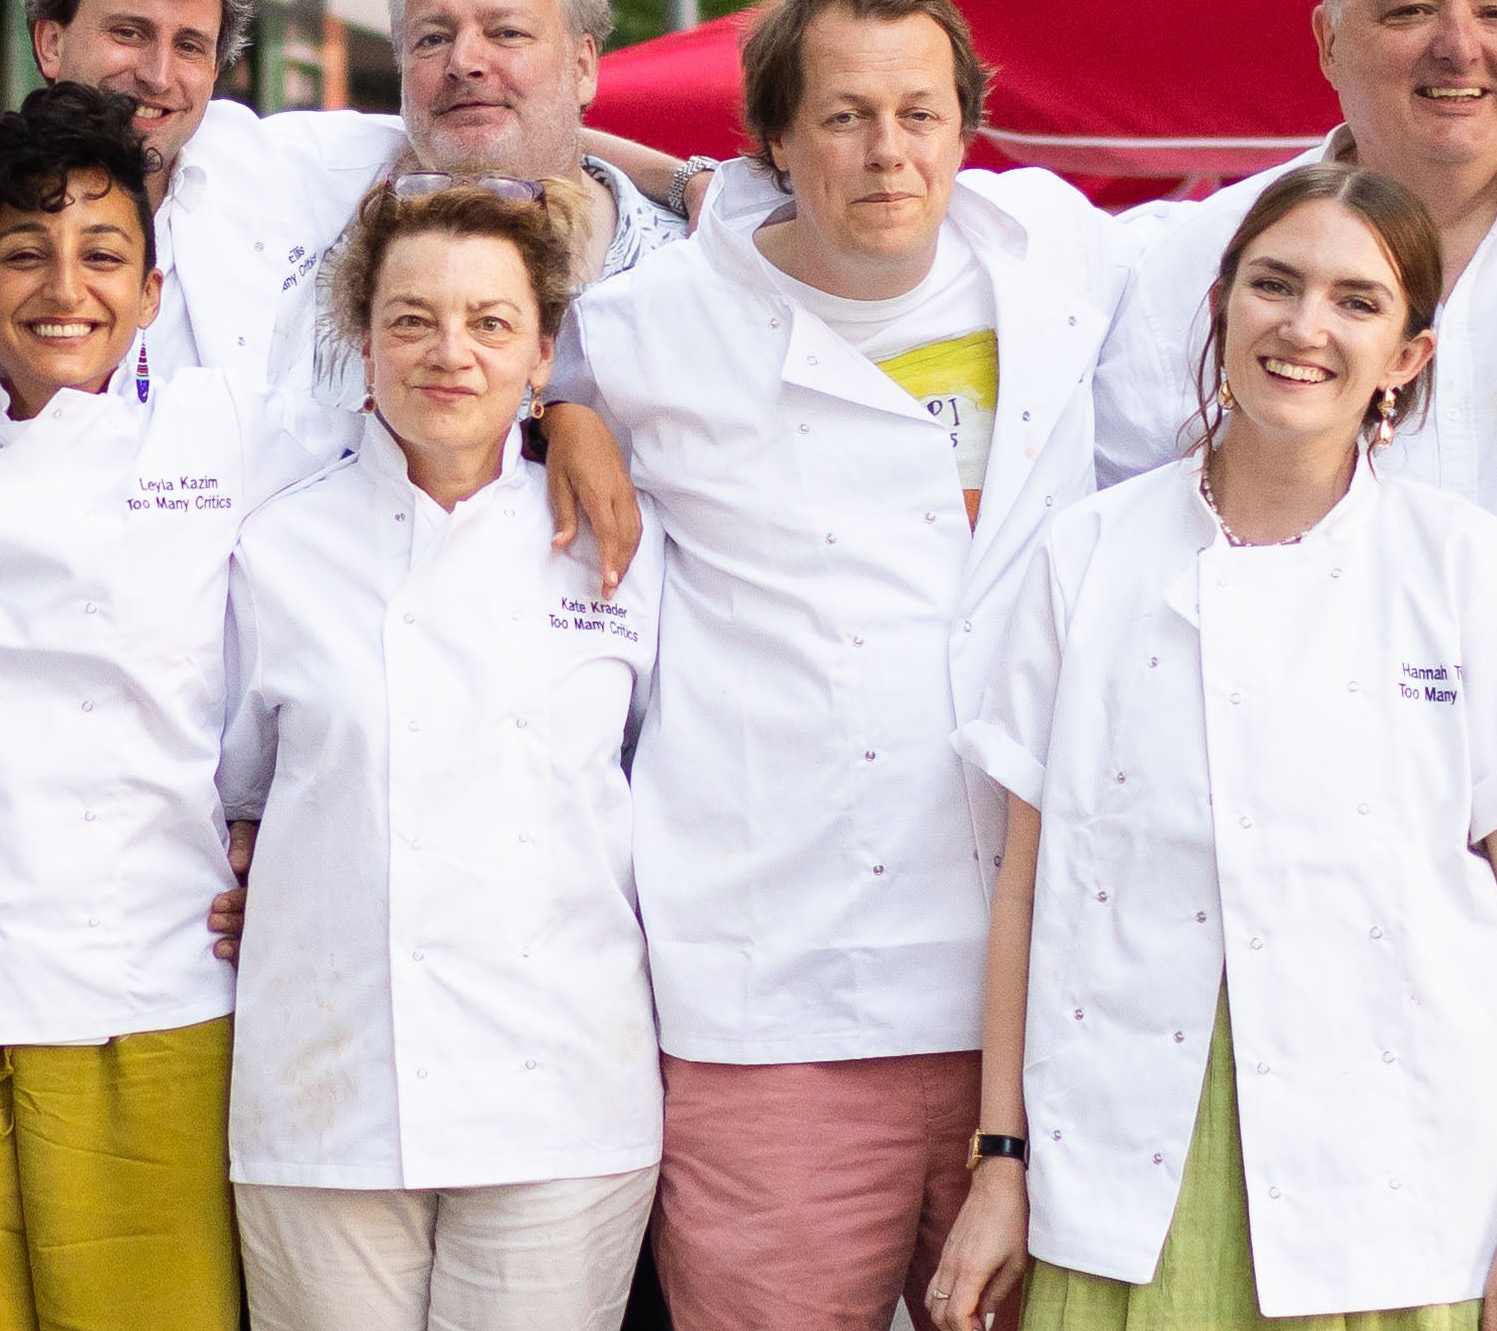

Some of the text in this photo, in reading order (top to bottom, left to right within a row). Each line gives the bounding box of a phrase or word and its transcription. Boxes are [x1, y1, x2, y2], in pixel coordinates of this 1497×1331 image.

[281, 273, 298, 293] any
[139, 475, 218, 493] Leyla Kazim
[127, 495, 231, 513] Too Many Critics
[561, 596, 627, 619] Kate Krader
[548, 614, 639, 643] Too Many Critics
[1402, 662, 1448, 680] Hannah
[1398, 682, 1458, 706] Too Many
